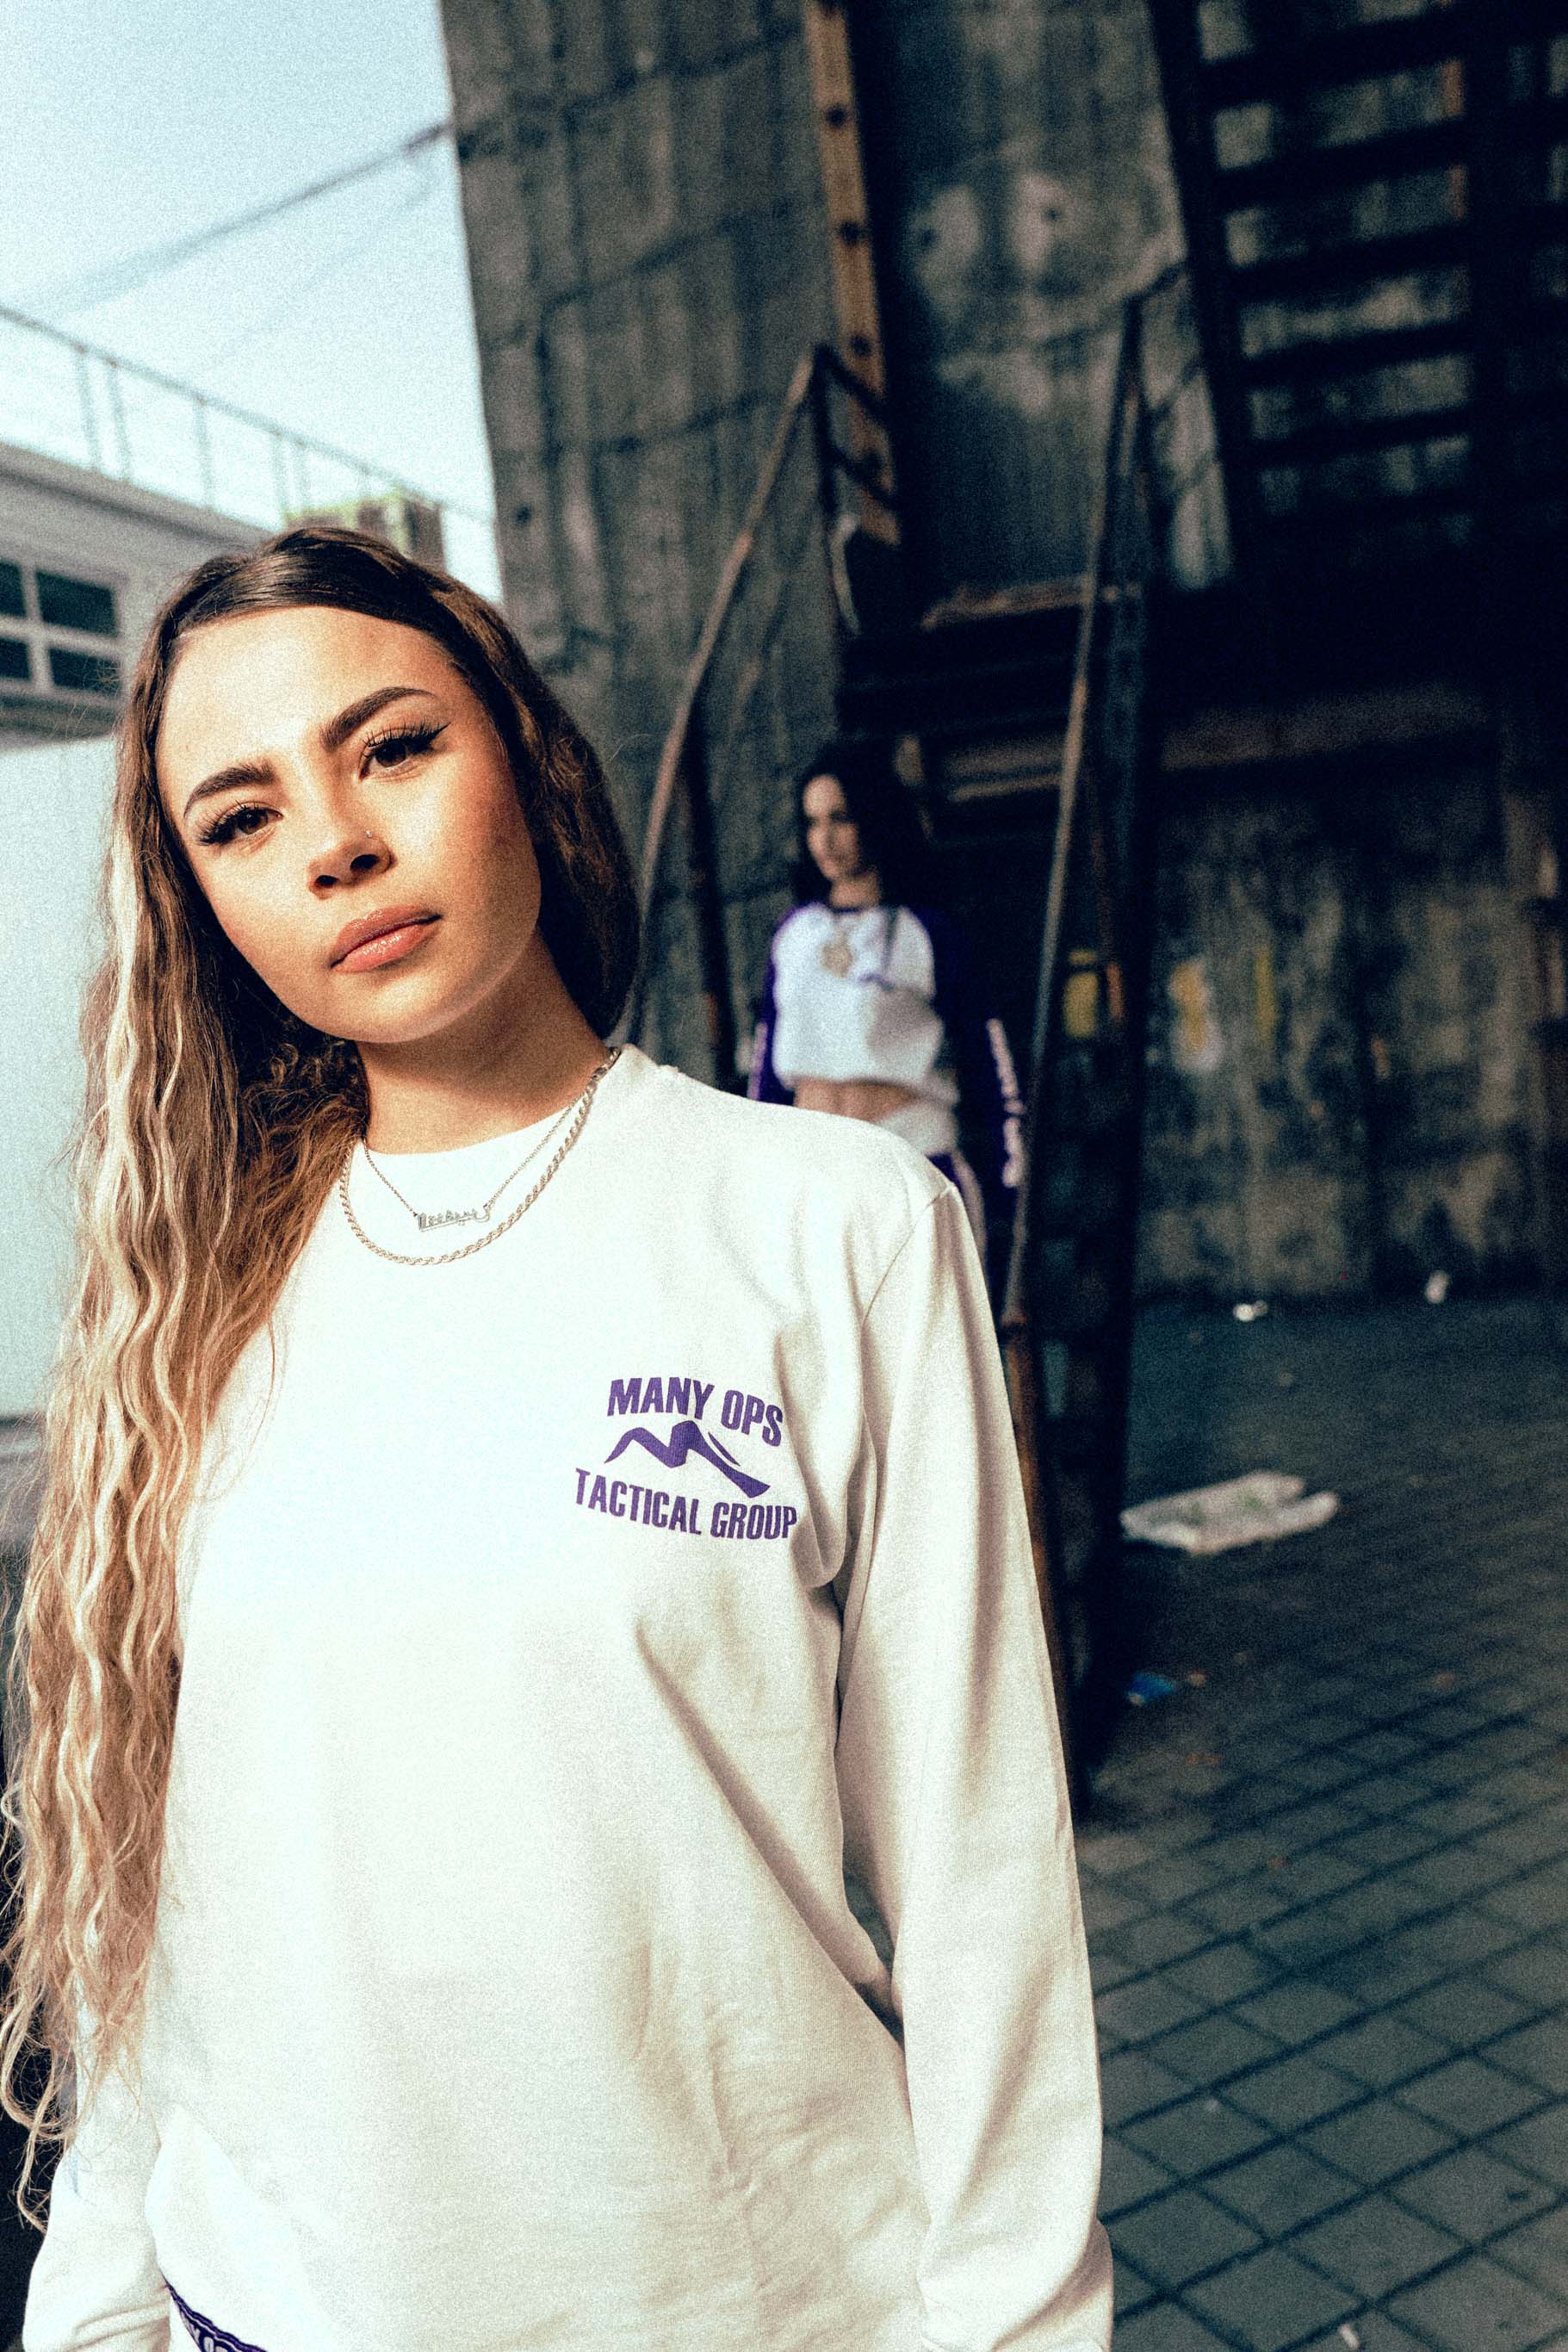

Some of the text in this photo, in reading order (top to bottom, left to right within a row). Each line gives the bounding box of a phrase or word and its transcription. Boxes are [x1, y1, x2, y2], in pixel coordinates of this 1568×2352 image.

[607, 1377, 784, 1447] MANY OPS
[575, 1468, 797, 1540] TACTICAL GROUP
